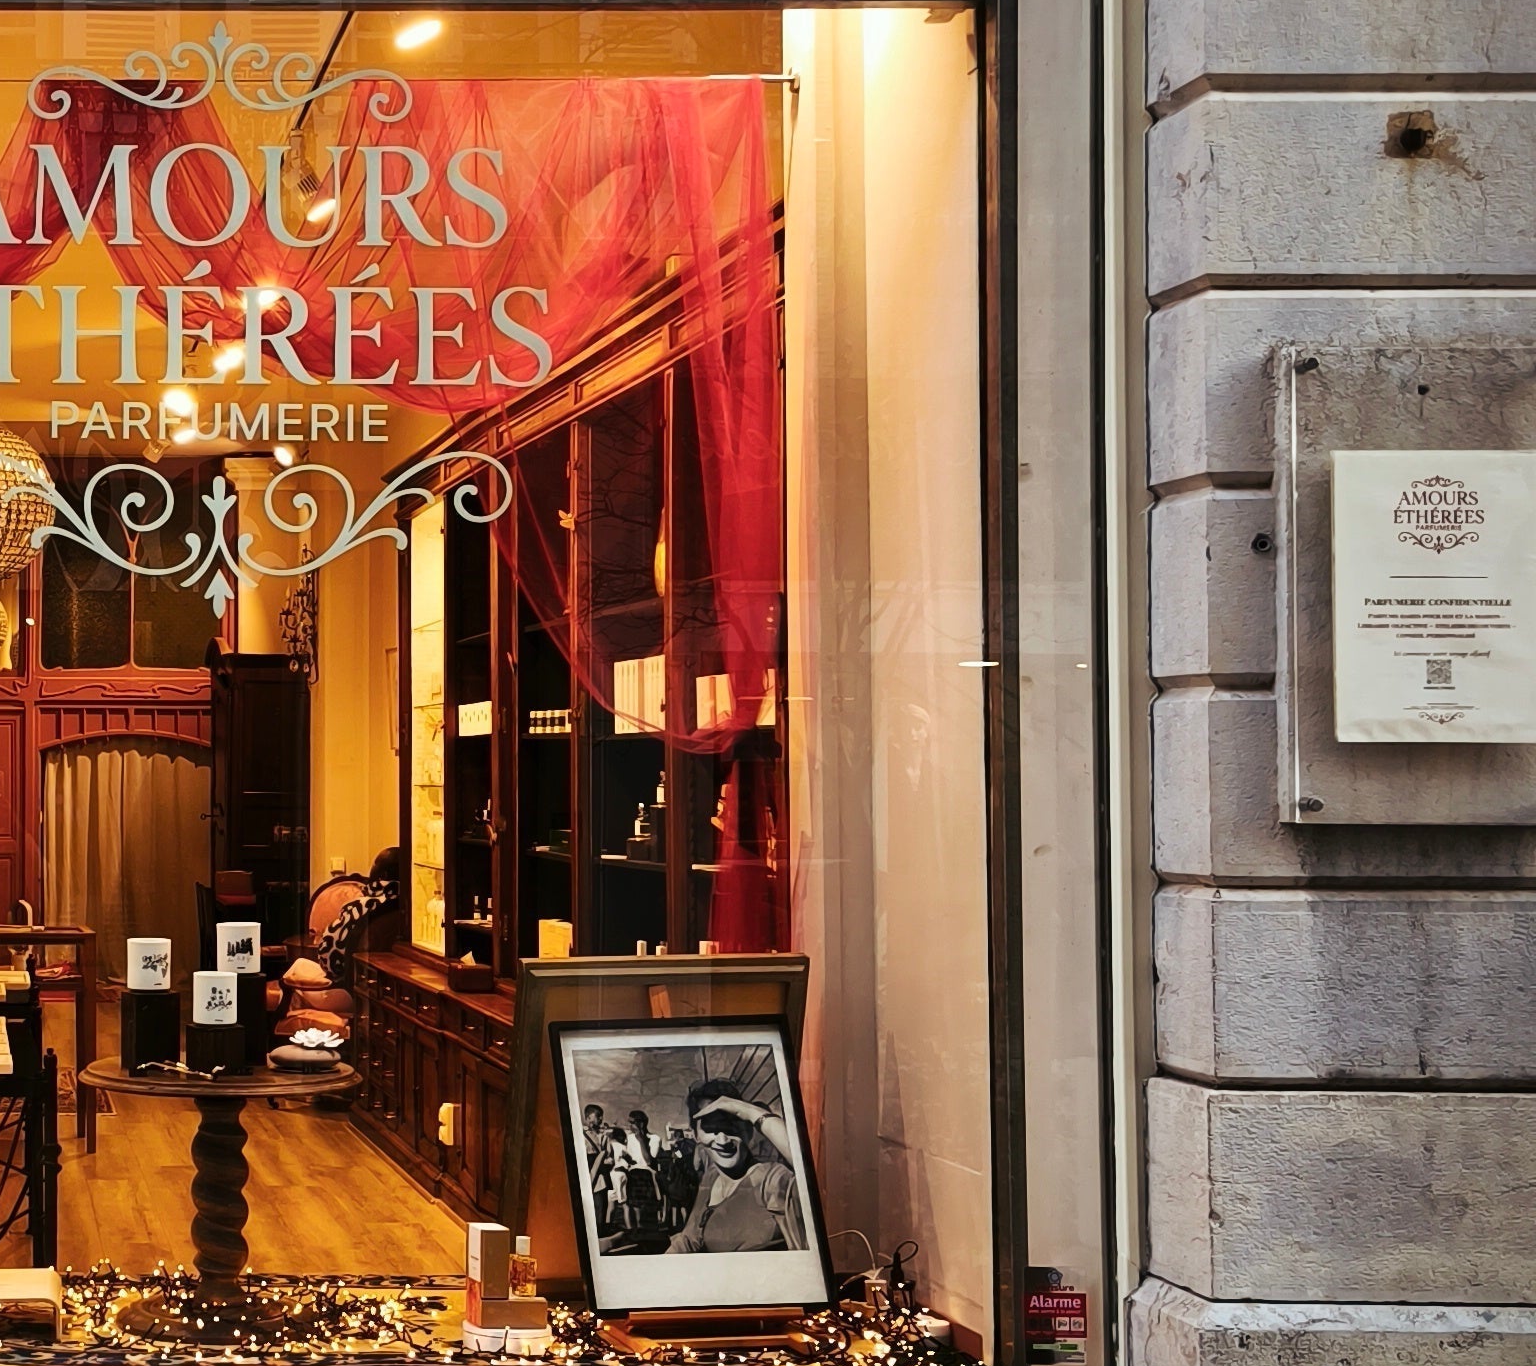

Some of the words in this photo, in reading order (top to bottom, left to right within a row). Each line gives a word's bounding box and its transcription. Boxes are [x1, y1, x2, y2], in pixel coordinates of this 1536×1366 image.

[50, 400, 390, 443] PARFUMERIE
[1398, 491, 1479, 506] AMOURS
[1393, 506, 1485, 524] ÉTHÉRÉES
[1029, 1295, 1082, 1308] Alarme
